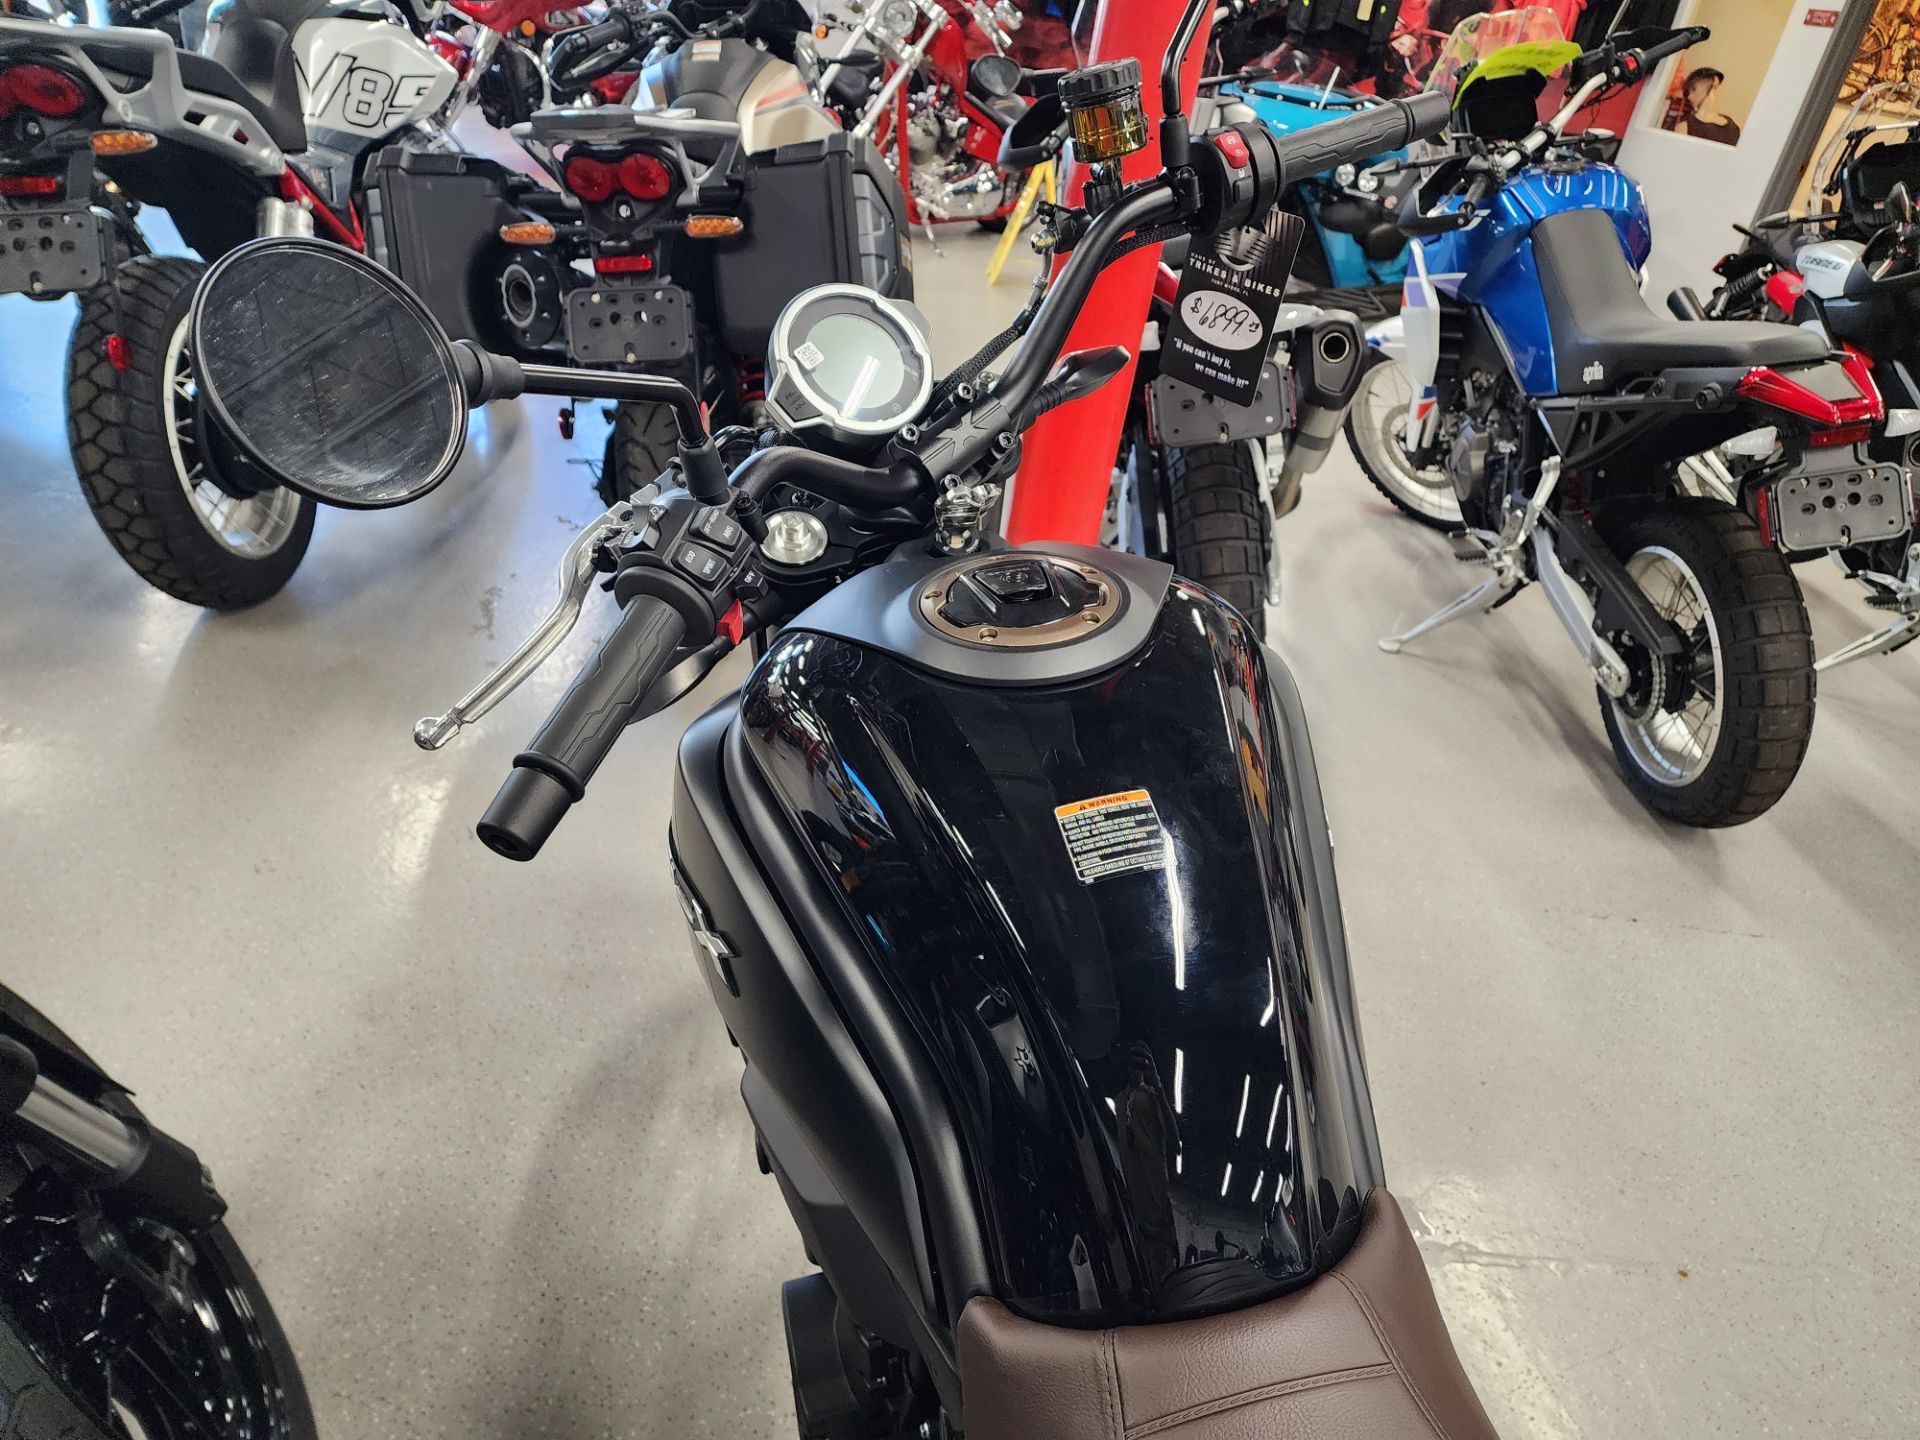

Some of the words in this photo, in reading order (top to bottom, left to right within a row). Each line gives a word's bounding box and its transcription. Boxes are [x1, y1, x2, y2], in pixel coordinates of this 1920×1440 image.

[1189, 257, 1227, 279] TRIKES
[1232, 273, 1240, 284] &
[1244, 279, 1281, 297] BIKES
[1194, 362, 1204, 373] we
[1217, 371, 1236, 385] make
[723, 525, 734, 539] ABS
[685, 550, 696, 564] ECO
[1089, 795, 1128, 808] WARNING
